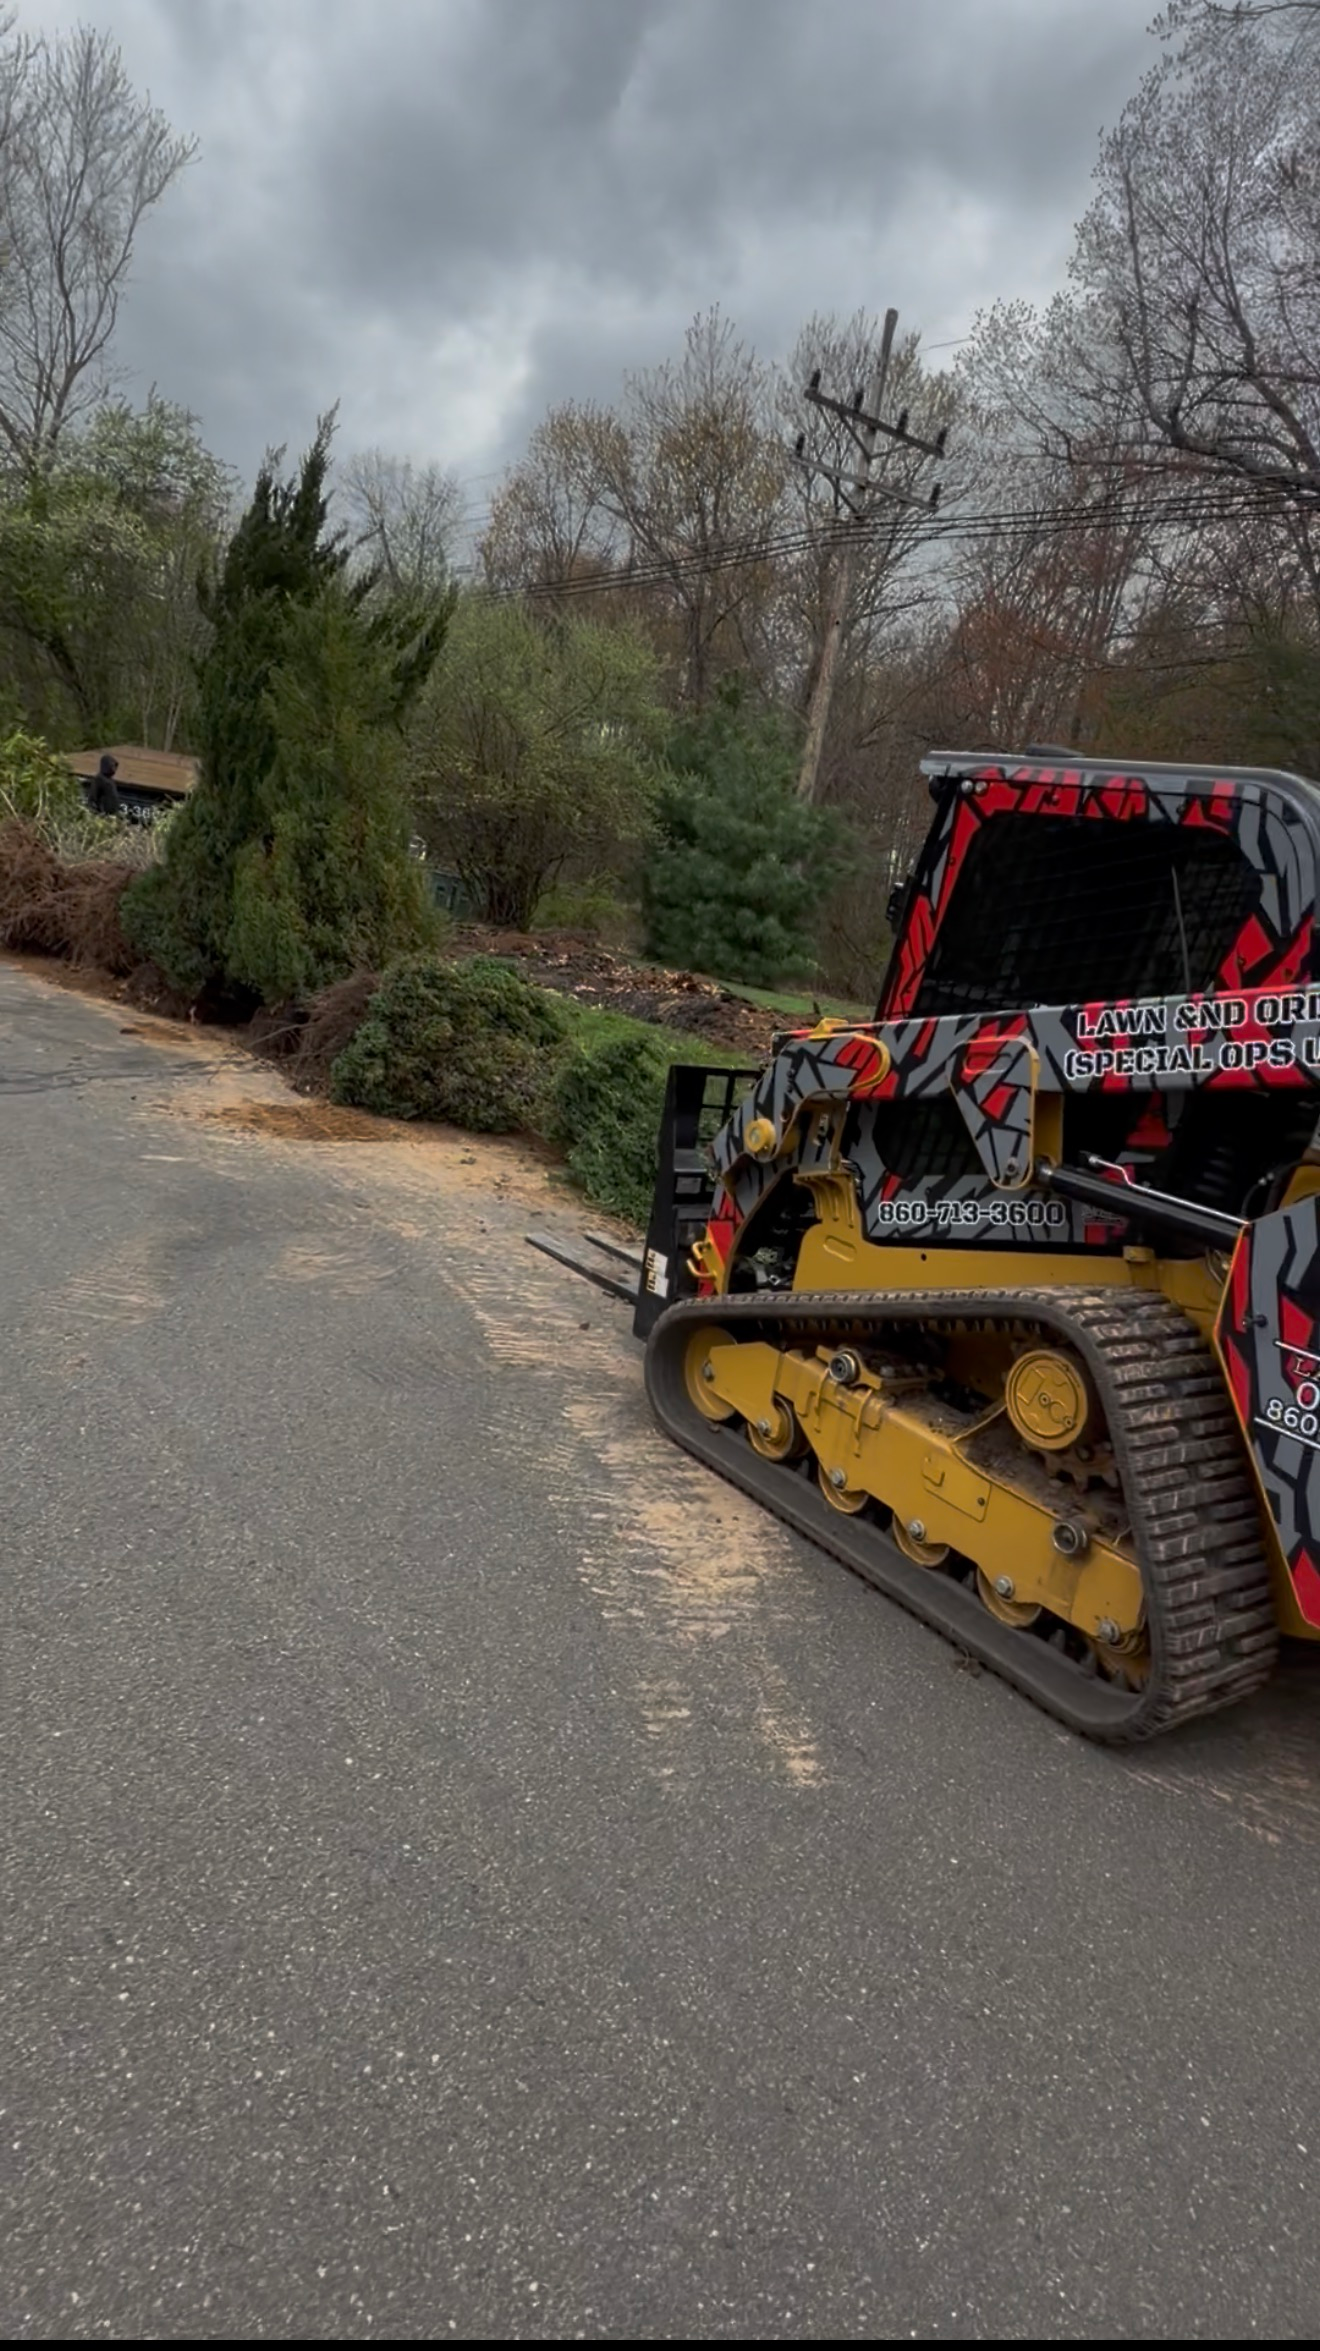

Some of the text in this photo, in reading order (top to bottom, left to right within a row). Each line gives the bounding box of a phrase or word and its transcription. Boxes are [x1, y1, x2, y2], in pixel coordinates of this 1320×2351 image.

[1077, 1006, 1166, 1038] LAWN
[1174, 999, 1248, 1032] &ND
[1065, 1045, 1212, 1080] (SPECIAL
[1220, 1039, 1296, 1071] OPS
[879, 1201, 1065, 1226] 860-713-3600
